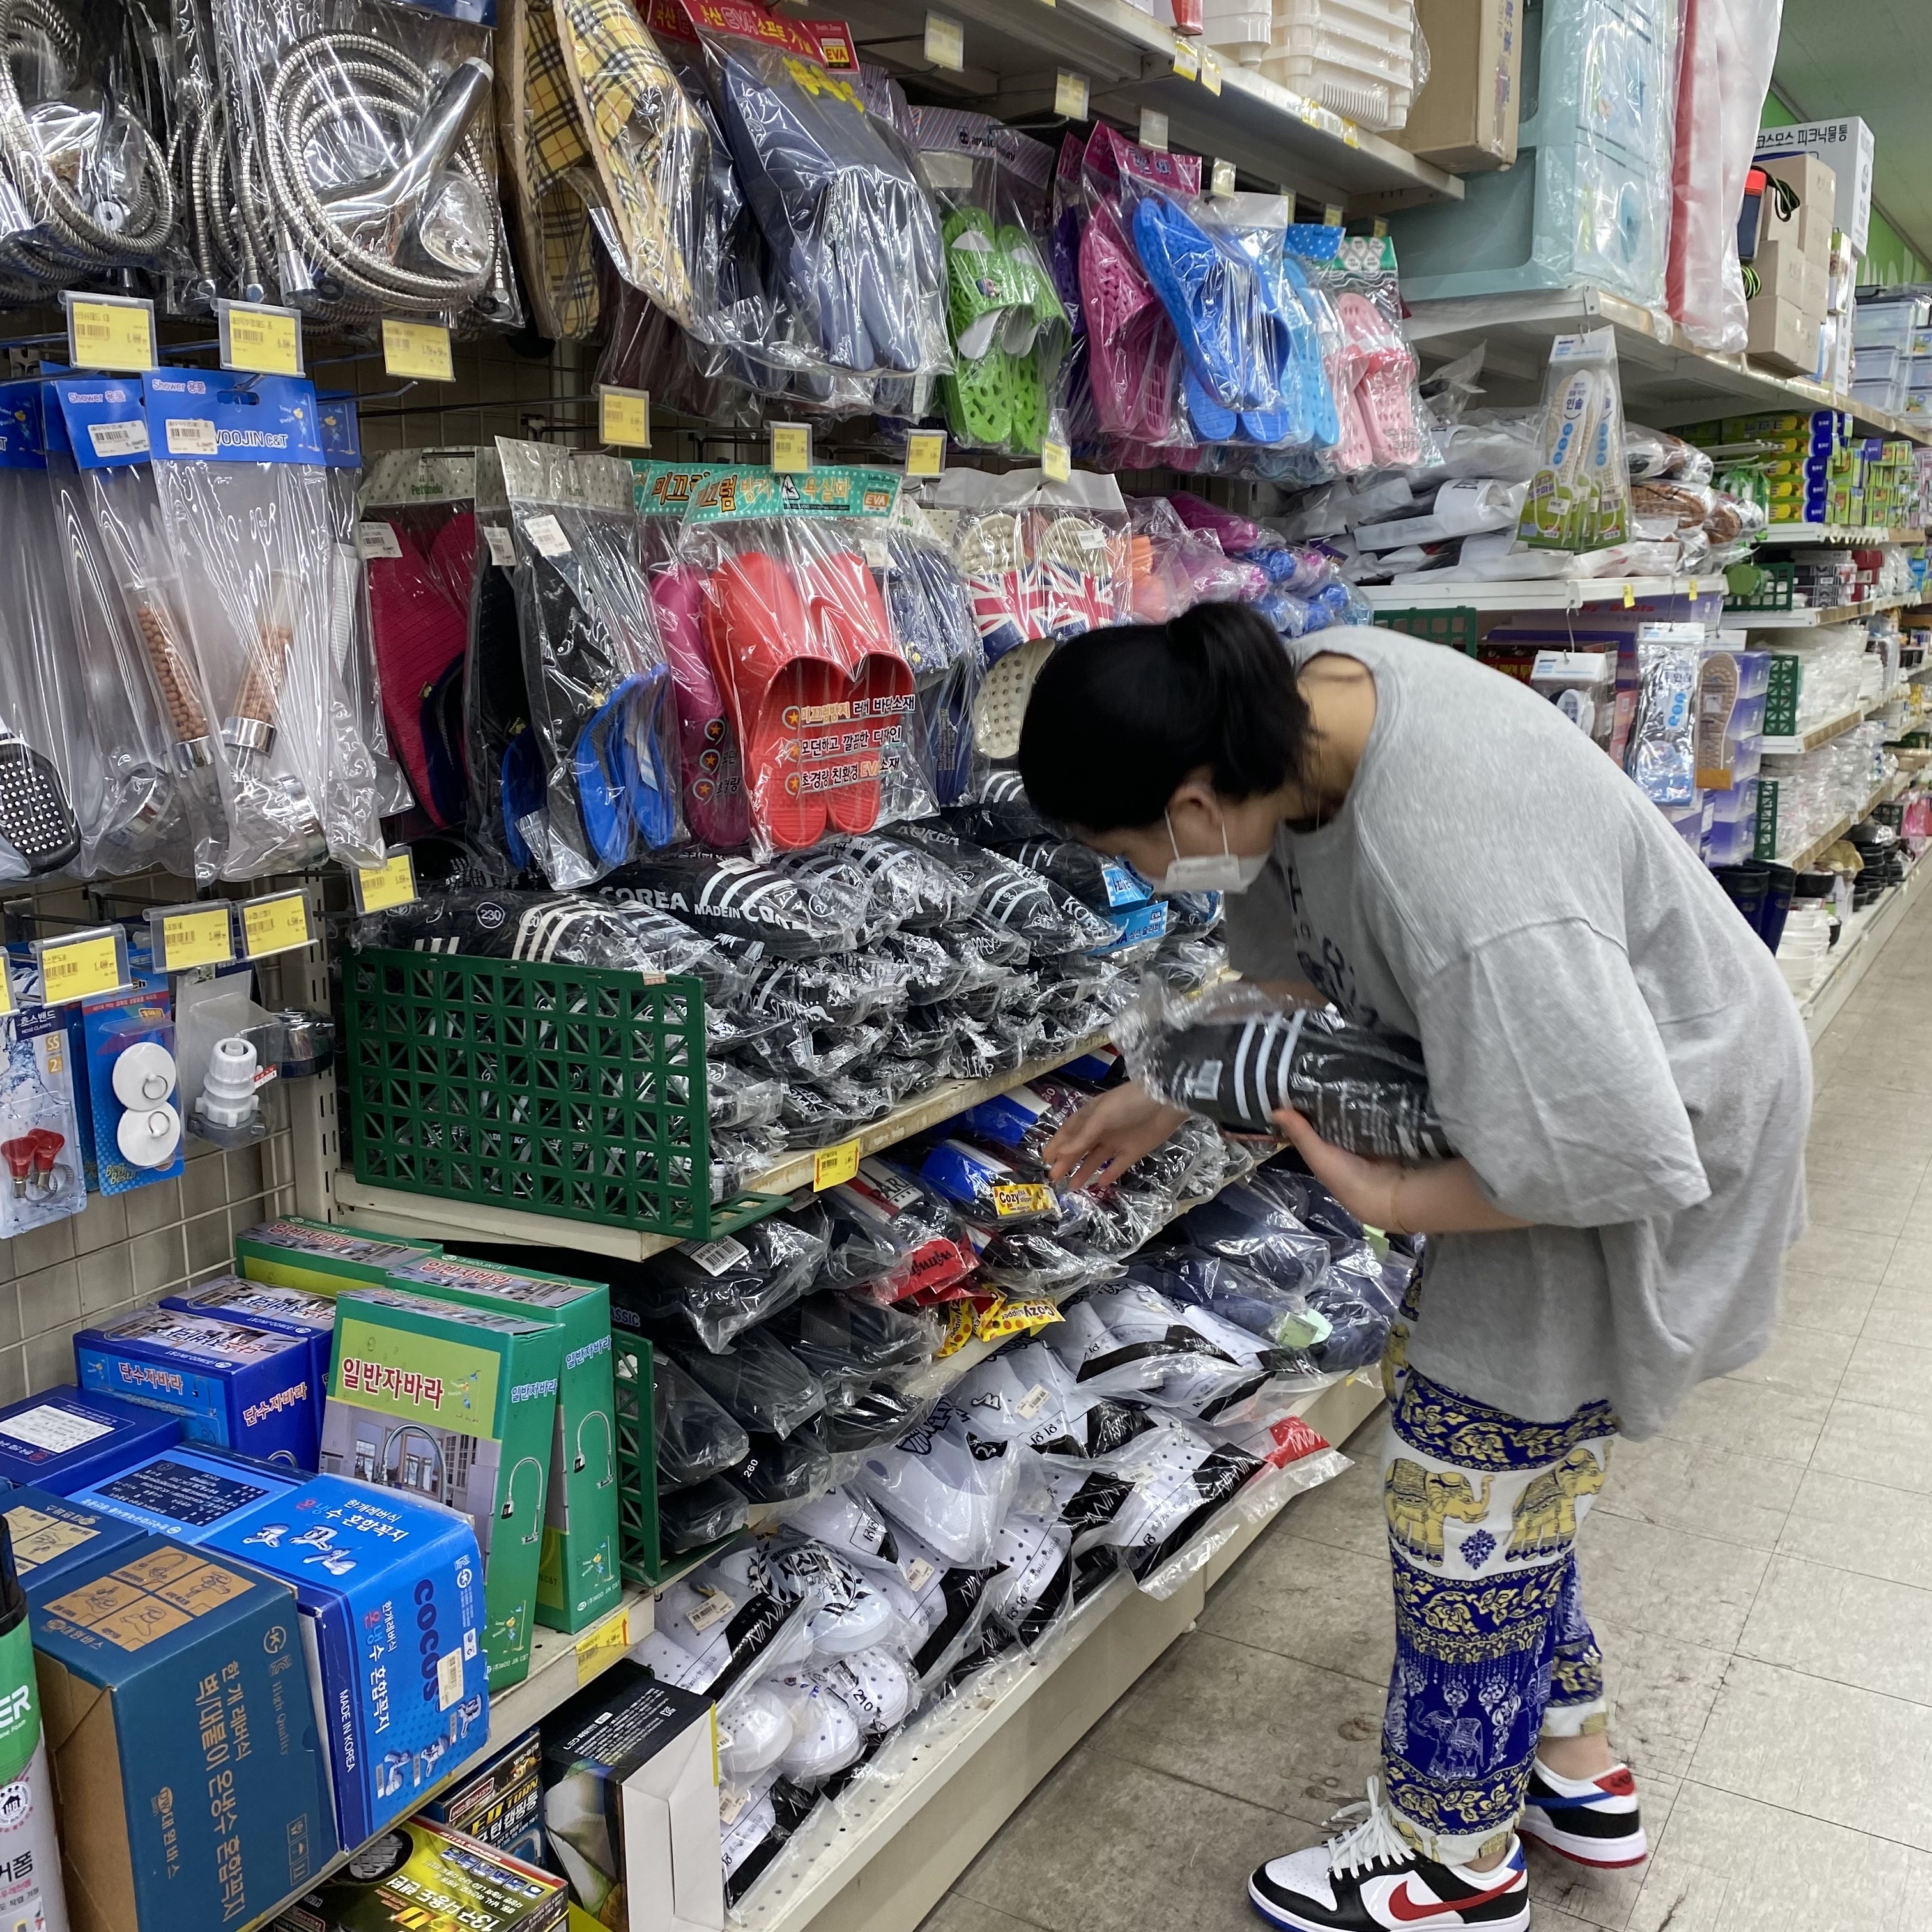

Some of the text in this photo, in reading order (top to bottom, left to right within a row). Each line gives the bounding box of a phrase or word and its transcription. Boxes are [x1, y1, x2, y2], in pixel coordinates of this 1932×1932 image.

[826, 48, 848, 63] EVA
[1756, 132, 1794, 149] 코스모스
[68, 392, 103, 404] Shower
[151, 379, 206, 394] Shower 용품
[264, 433, 288, 448] C&T
[739, 476, 772, 504] 방지
[801, 475, 852, 503] 욕실화
[865, 494, 886, 505] EVA
[801, 702, 850, 723] 미끄럼방지
[801, 725, 902, 756] 모던하고 깔끔한 디자인
[801, 770, 830, 790] 초경량
[832, 762, 859, 784] 친환경
[480, 908, 502, 921] 230
[1142, 924, 1161, 937] 슬리퍼
[20, 1009, 56, 1027] 호스밴드
[47, 1036, 60, 1051] SS
[999, 1192, 1020, 1208] Cozy
[268, 1222, 355, 1250] 일반자바라
[420, 1261, 512, 1287] 일반자바라
[610, 1305, 641, 1328] ASSIC
[1001, 1305, 1055, 1320] Cozy slipper
[565, 1335, 612, 1369] 일반자바라
[118, 1362, 183, 1395] 단수자바라
[341, 1358, 444, 1410] 일반자바라
[512, 1378, 558, 1403] 일반자바라
[243, 1382, 308, 1427] 단수자바라
[743, 1459, 762, 1478] 260
[295, 1497, 410, 1543] 온냉수 혼합꼭지
[342, 1498, 402, 1524] 한개레버식
[382, 1600, 399, 1654] 한개레버식
[414, 1578, 441, 1703] COCOS
[363, 1608, 391, 1735] 온냉수 혼합꼭지
[852, 1689, 873, 1712] 210
[272, 1680, 289, 1756] High Quality
[339, 1689, 356, 1773] MADE IN KOREA
[208, 1769, 238, 1835] 온냉수
[506, 1775, 539, 1809] TURN
[504, 1791, 539, 1830] 캠핑등
[215, 1834, 245, 1924] 혼합꼭지
[471, 1882, 489, 1895] LED
[385, 1874, 501, 1932] 13구 다용도 랜턴
